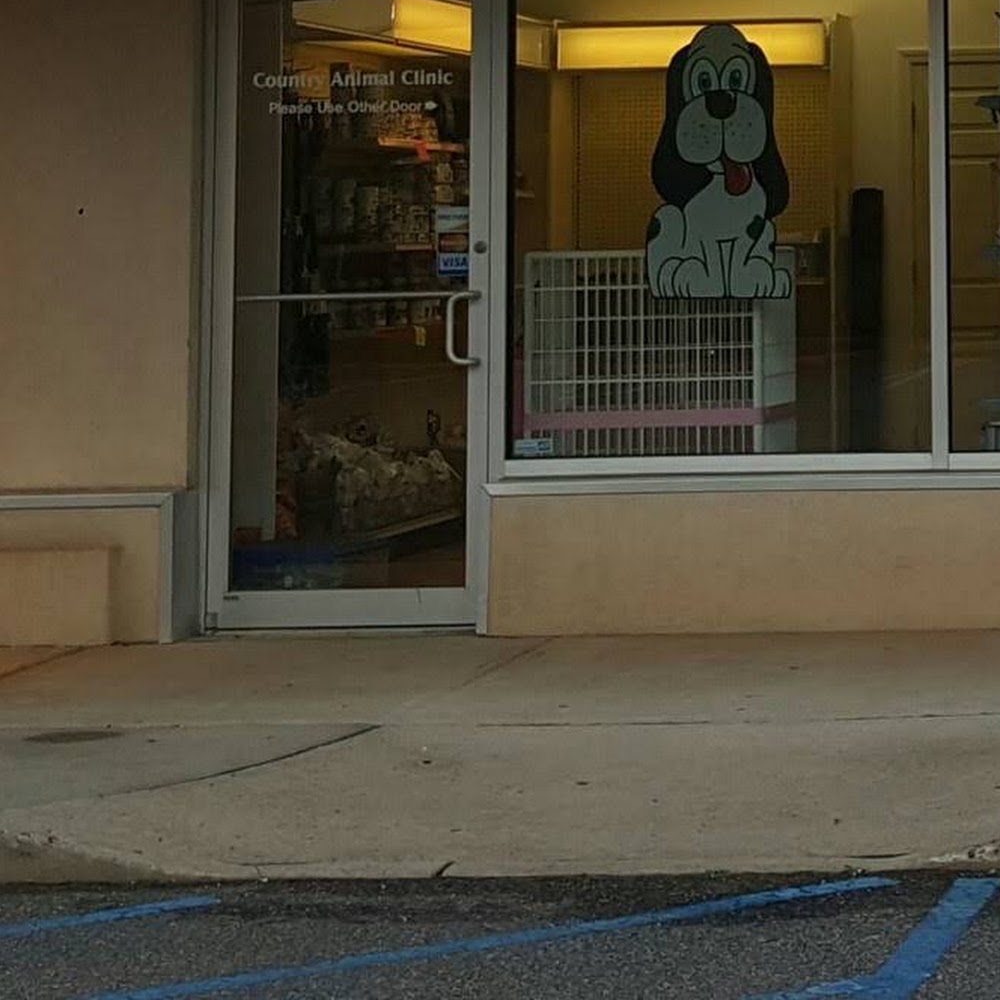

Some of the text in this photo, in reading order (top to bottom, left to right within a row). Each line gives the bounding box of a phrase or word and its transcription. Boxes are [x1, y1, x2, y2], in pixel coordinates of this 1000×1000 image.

[252, 68, 454, 90] Country Animal Clinic
[269, 100, 422, 114] Please Use Other Door
[441, 256, 468, 267] VISA
